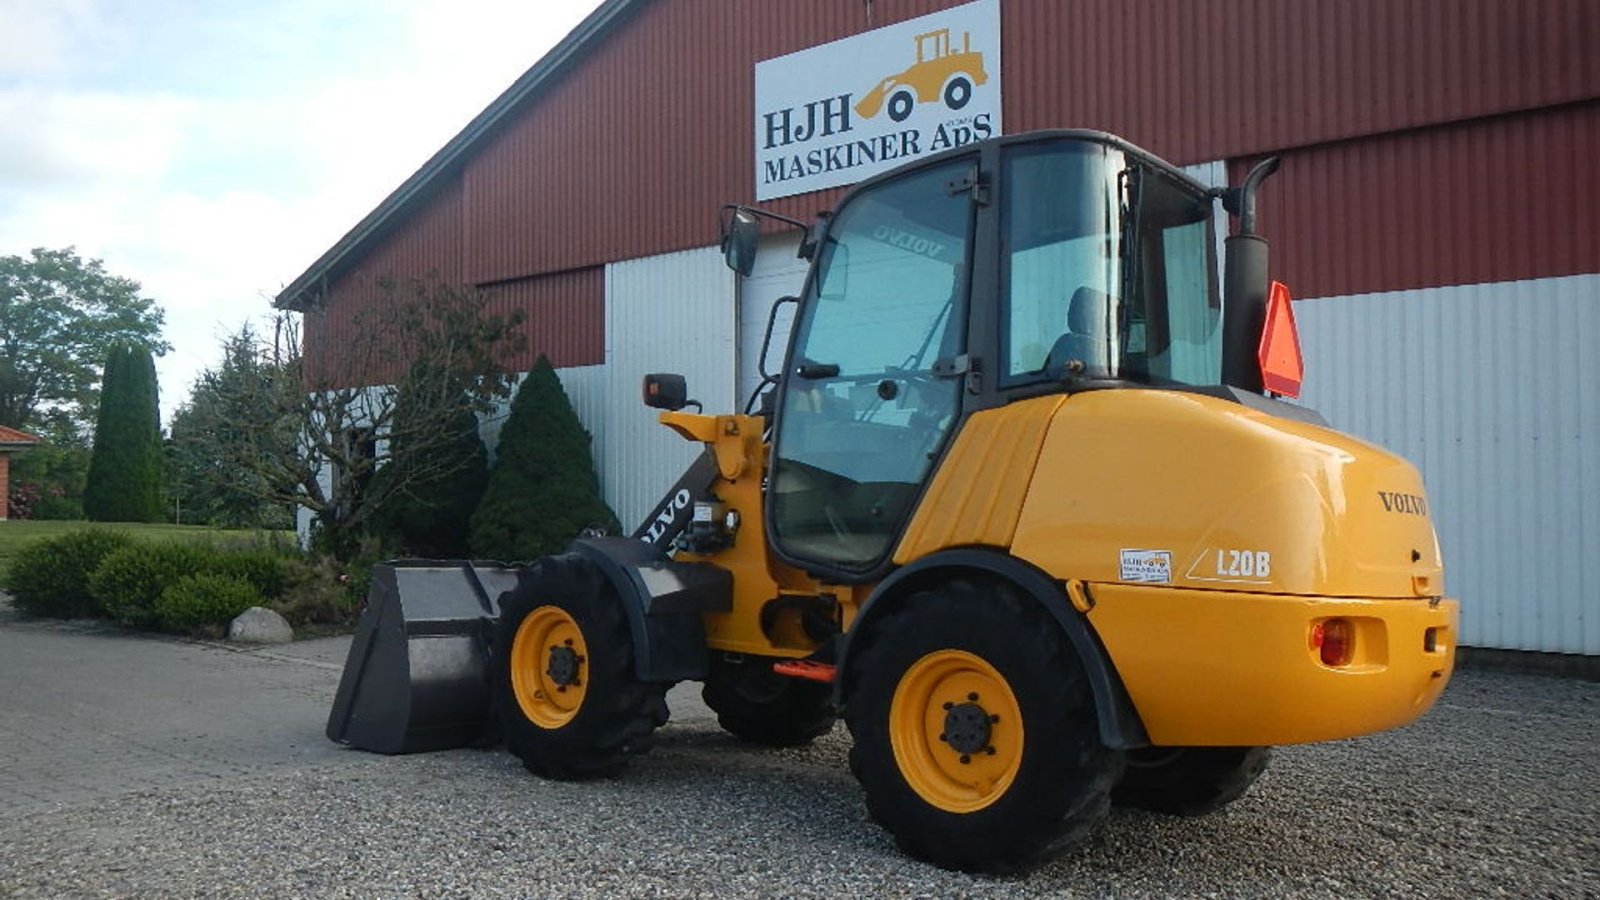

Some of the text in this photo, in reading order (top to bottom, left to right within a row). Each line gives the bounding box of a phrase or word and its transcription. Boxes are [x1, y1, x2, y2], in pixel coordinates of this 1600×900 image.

[763, 93, 853, 149] HJH
[764, 113, 991, 184] MASKINER ApS
[1377, 491, 1426, 516] VOLVO
[1217, 550, 1270, 578] L20B
